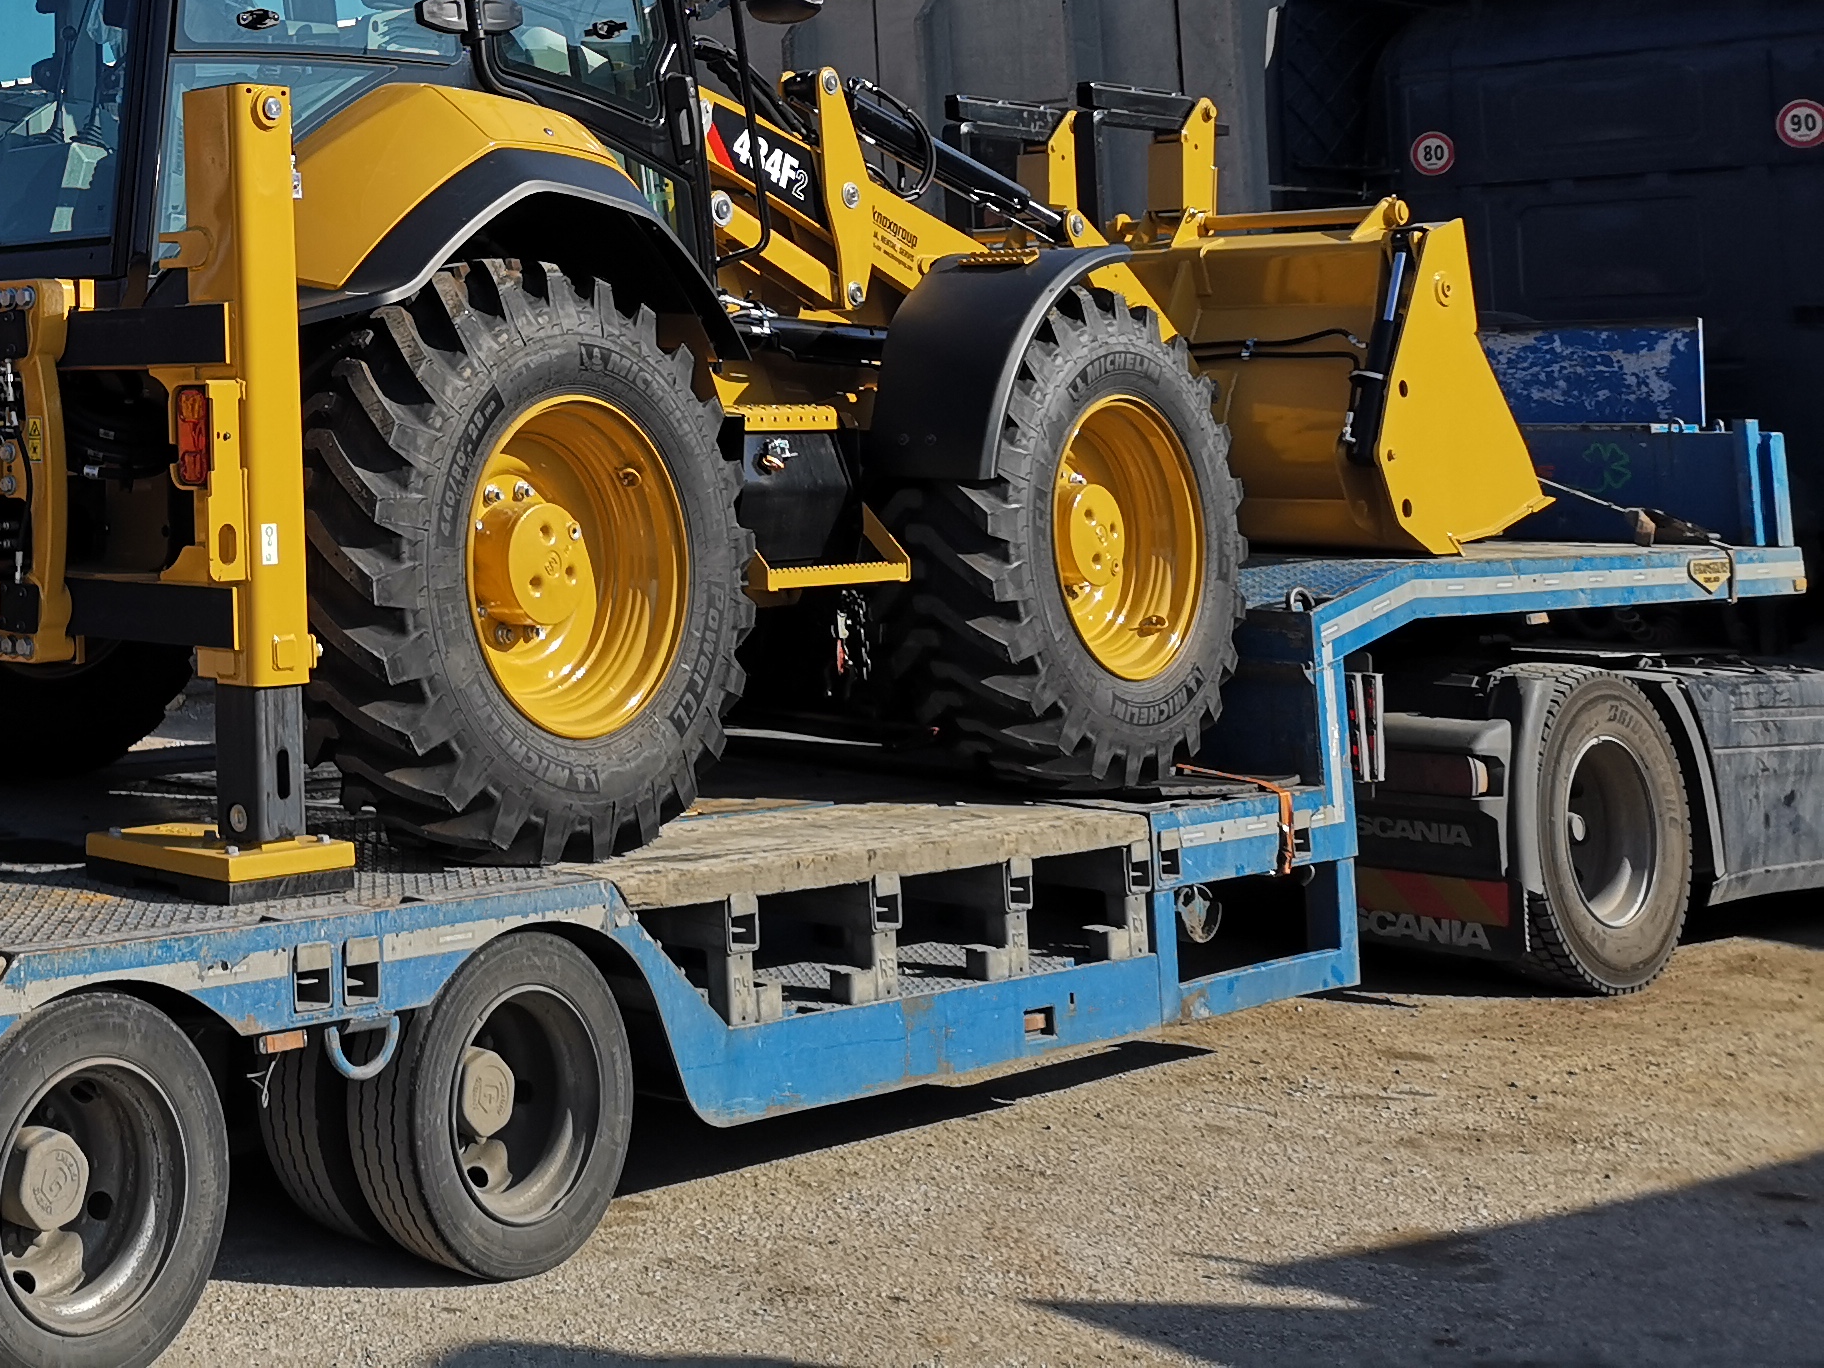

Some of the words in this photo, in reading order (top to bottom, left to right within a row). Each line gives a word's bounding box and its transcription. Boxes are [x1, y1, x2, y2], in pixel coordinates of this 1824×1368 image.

[1790, 113, 1816, 133] 90
[1423, 144, 1445, 162] 80
[1085, 352, 1161, 386] MICHELIN
[673, 691, 698, 728] CL
[1112, 686, 1188, 725] MICHELIN
[465, 682, 570, 787] MICHELIN
[1357, 814, 1473, 848] SCANIA
[878, 956, 896, 980] R3
[733, 975, 751, 998] R4
